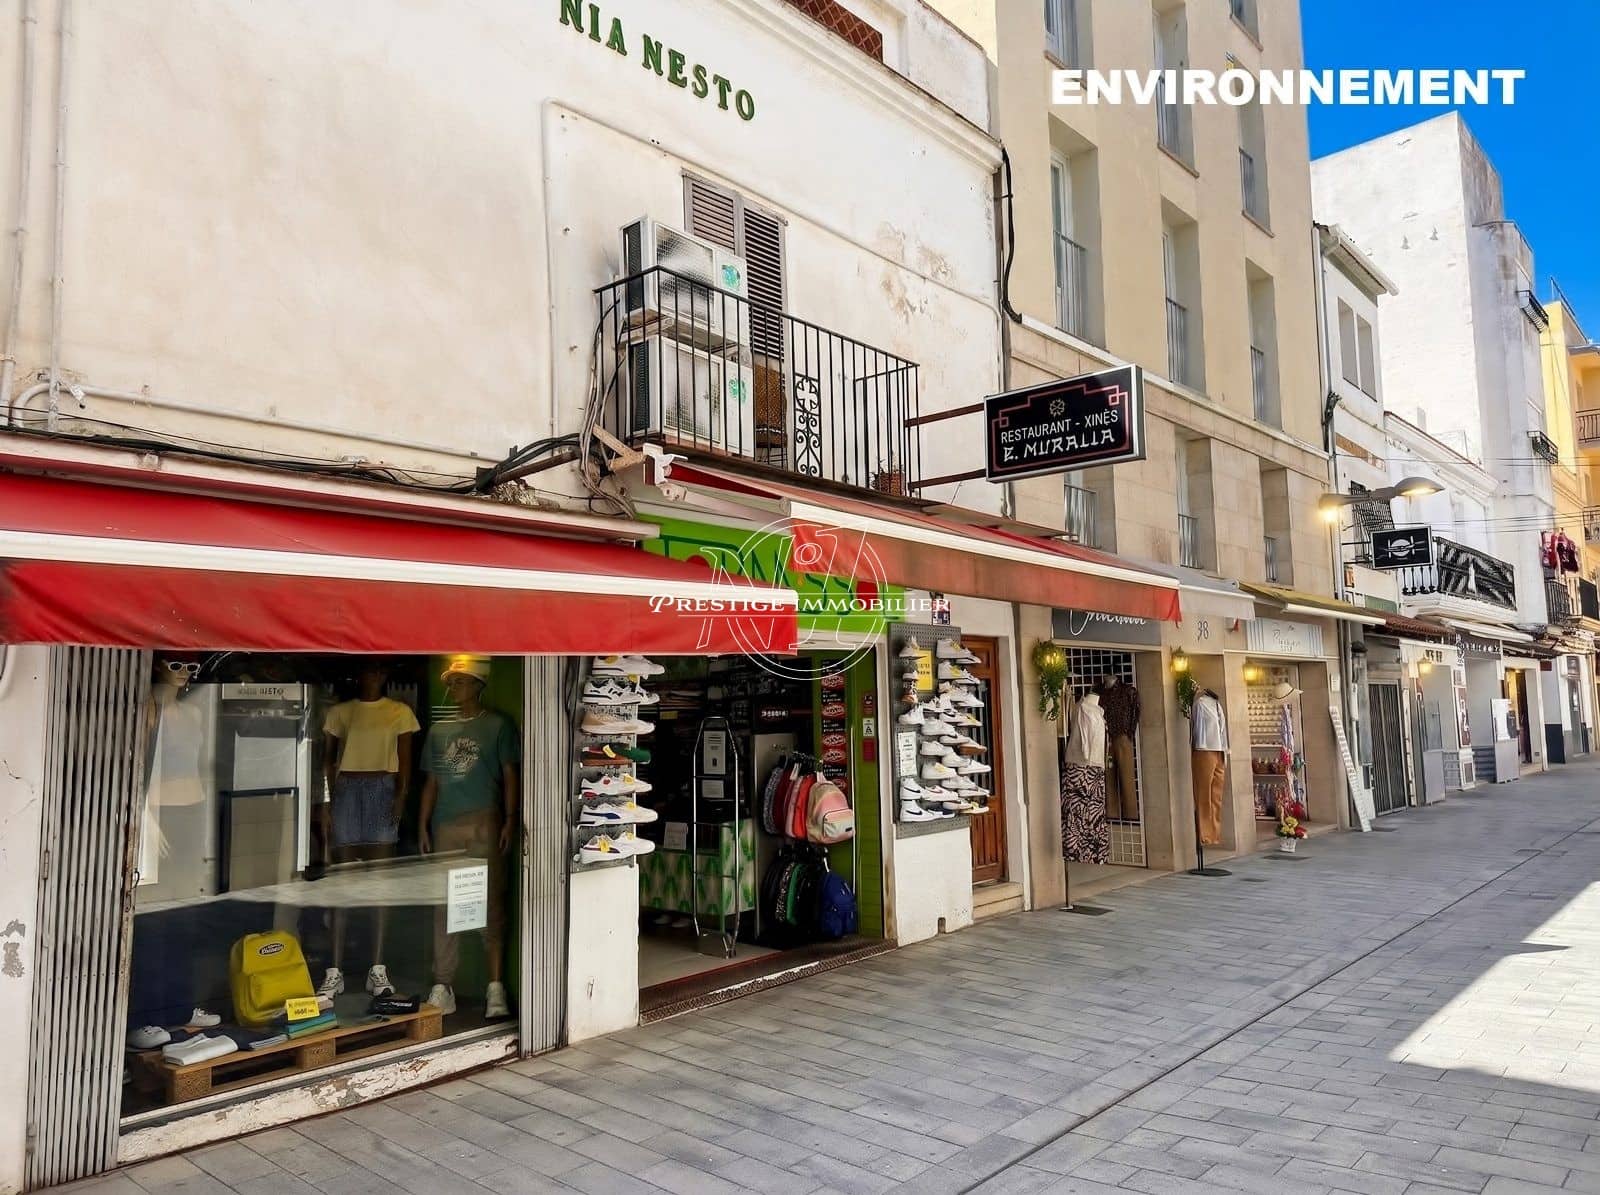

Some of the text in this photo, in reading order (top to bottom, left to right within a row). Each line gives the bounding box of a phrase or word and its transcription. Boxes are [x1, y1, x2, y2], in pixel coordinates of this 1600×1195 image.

[642, 34, 755, 121] NESTO
[1001, 418, 1072, 444] RESTAURANT
[1023, 428, 1115, 458] MURALLA
[1197, 620, 1209, 642] 38
